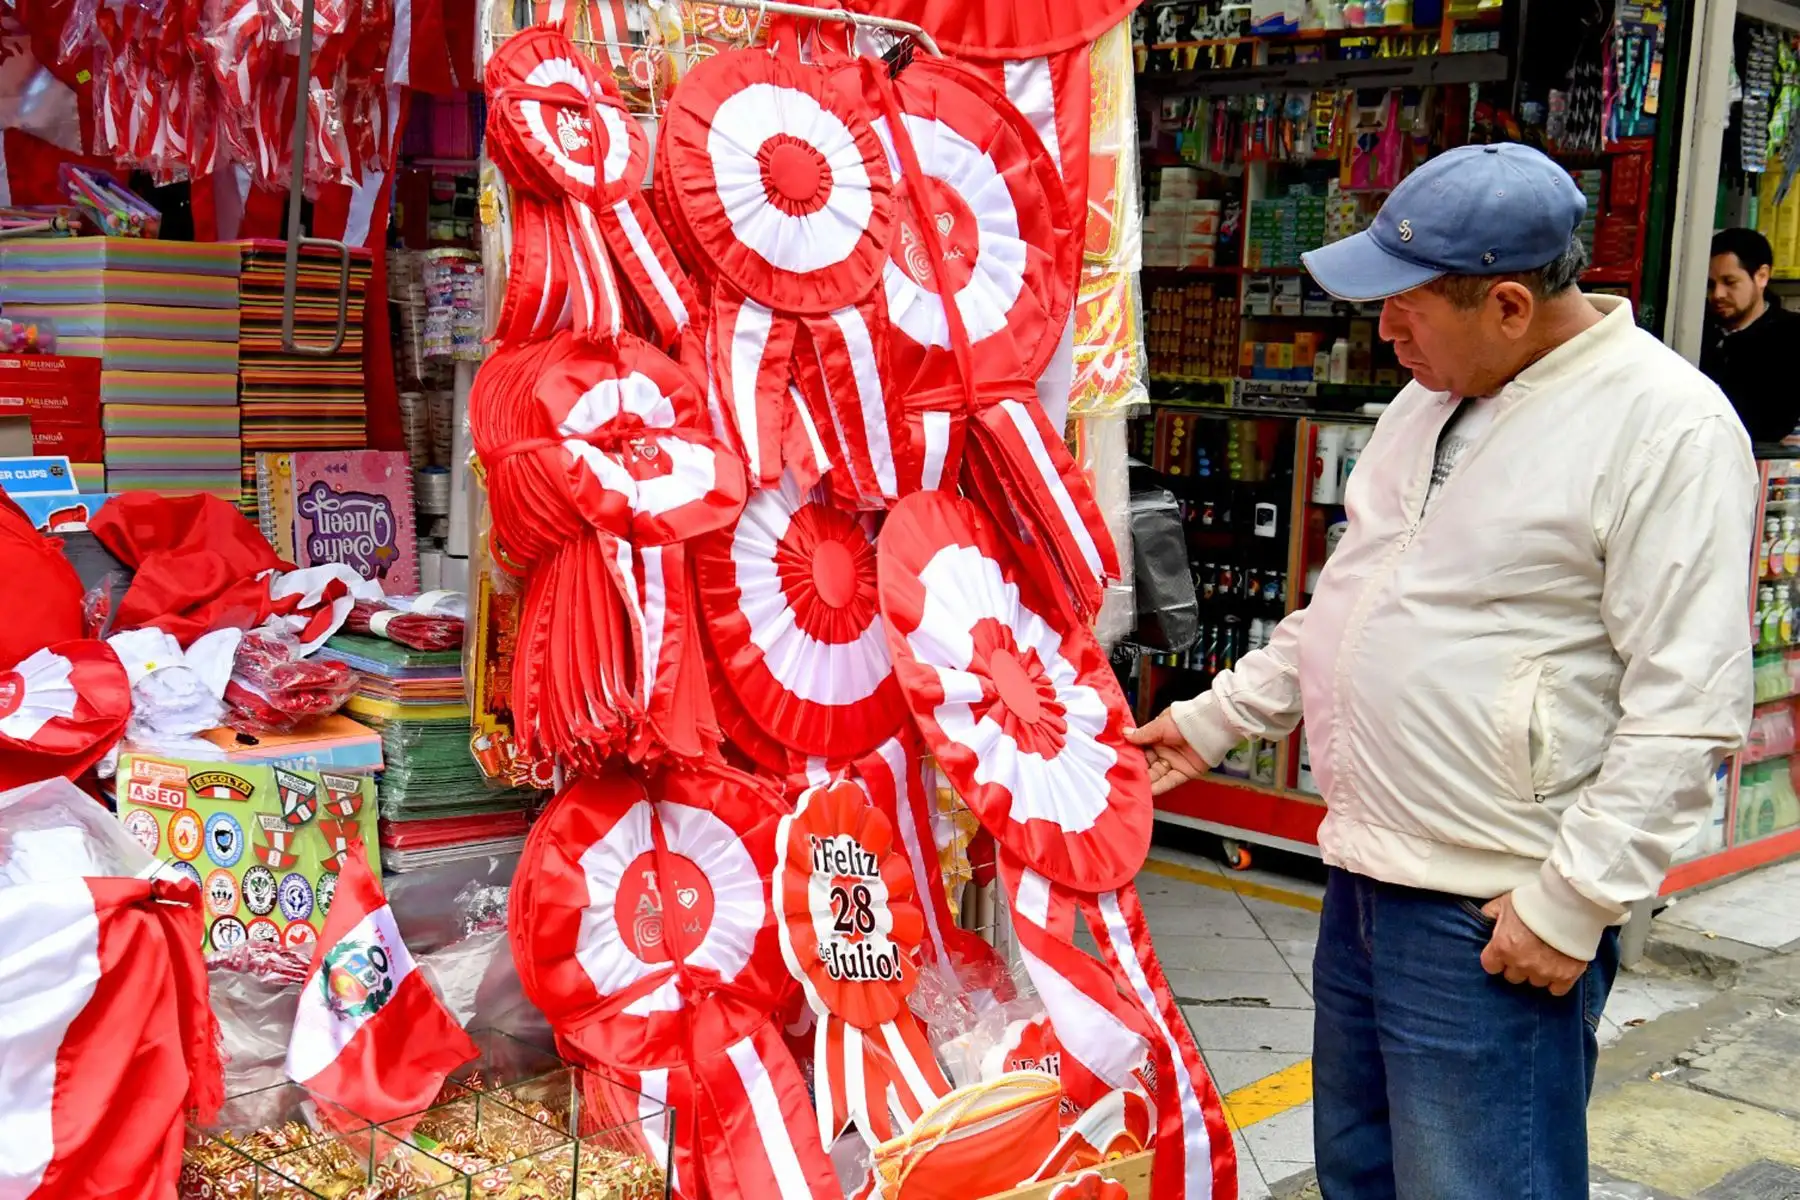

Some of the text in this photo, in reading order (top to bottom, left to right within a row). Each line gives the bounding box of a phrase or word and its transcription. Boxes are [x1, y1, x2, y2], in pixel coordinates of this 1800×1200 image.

[22, 359, 67, 369] MILLENIUM
[25, 396, 69, 406] MILLENIUM
[15, 469, 48, 479] CLIPS
[302, 488, 391, 547] Queen
[313, 534, 374, 576] Selfie
[134, 785, 181, 805] ASEO
[195, 775, 250, 791] ESCOLTA
[811, 836, 880, 877] ¡Feliz
[830, 884, 876, 934] 28
[819, 941, 902, 979] de Julio!
